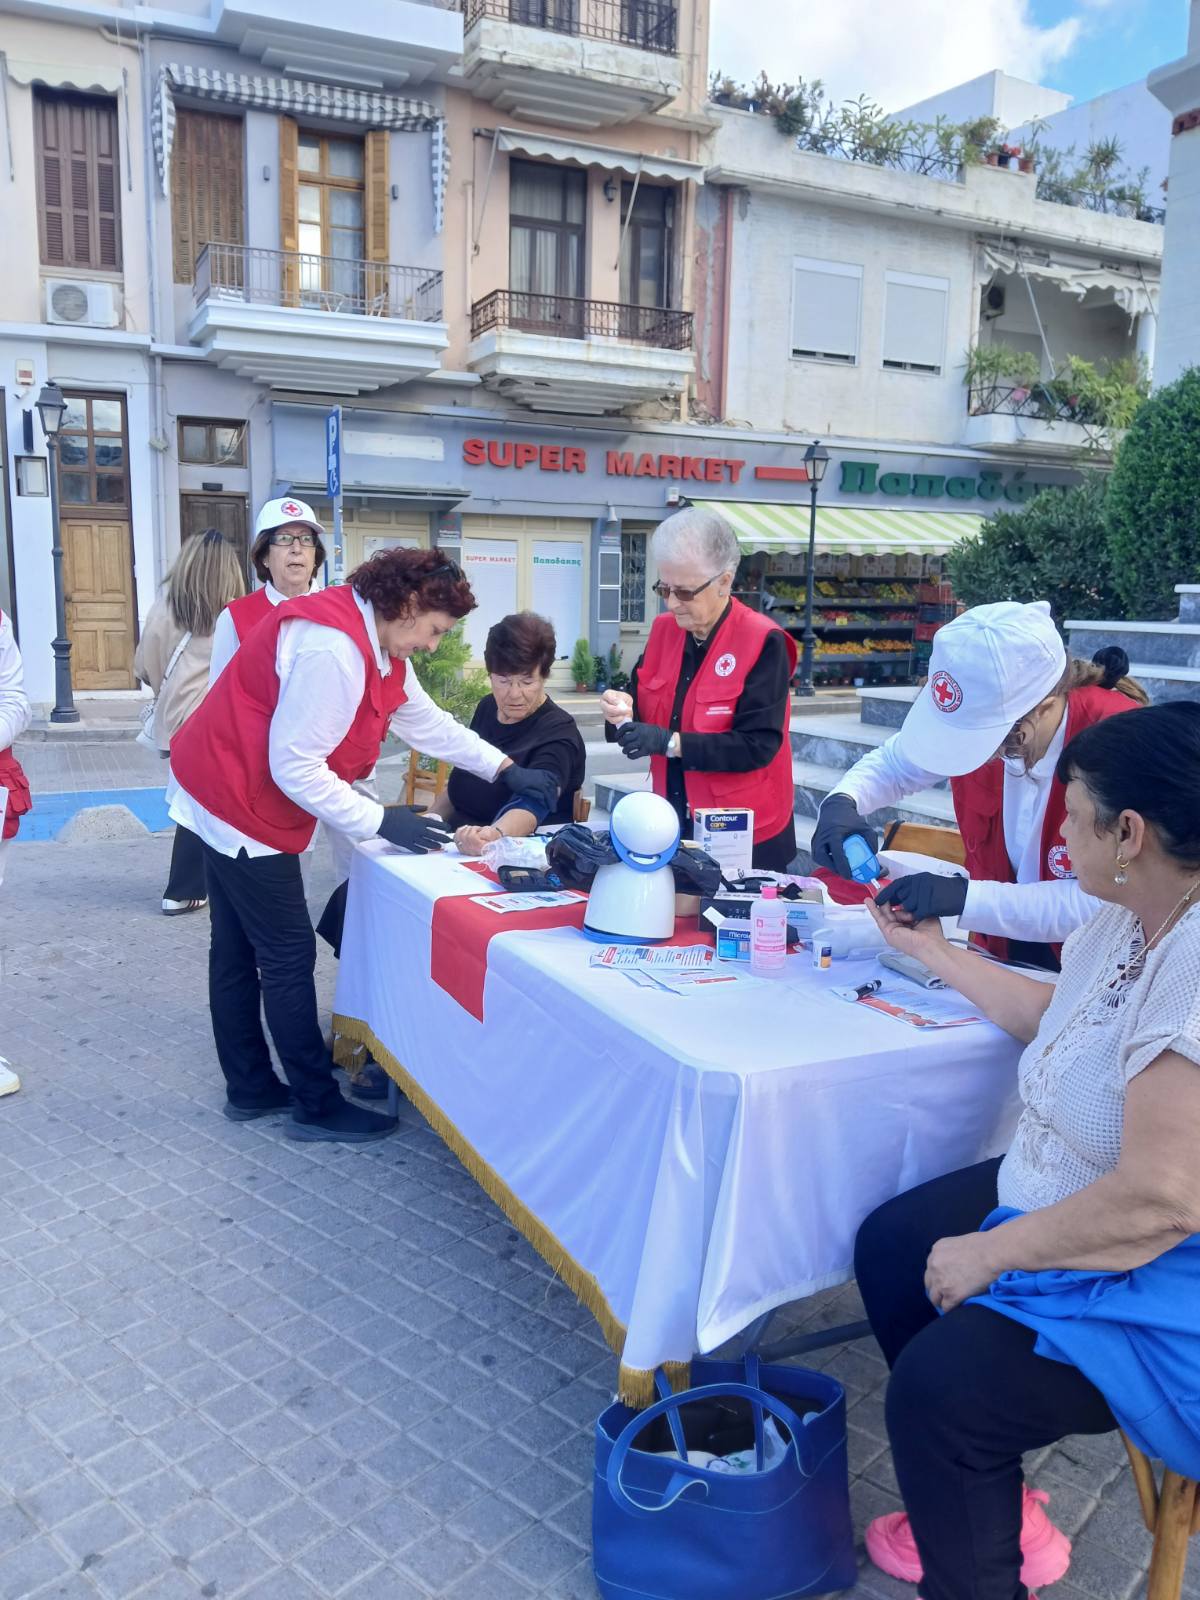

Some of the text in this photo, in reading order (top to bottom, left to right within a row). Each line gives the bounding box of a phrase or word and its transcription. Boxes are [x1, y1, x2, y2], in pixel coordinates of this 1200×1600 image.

[463, 438, 746, 484] SUPER MARKET
[839, 460, 1073, 502] Παπαδά
